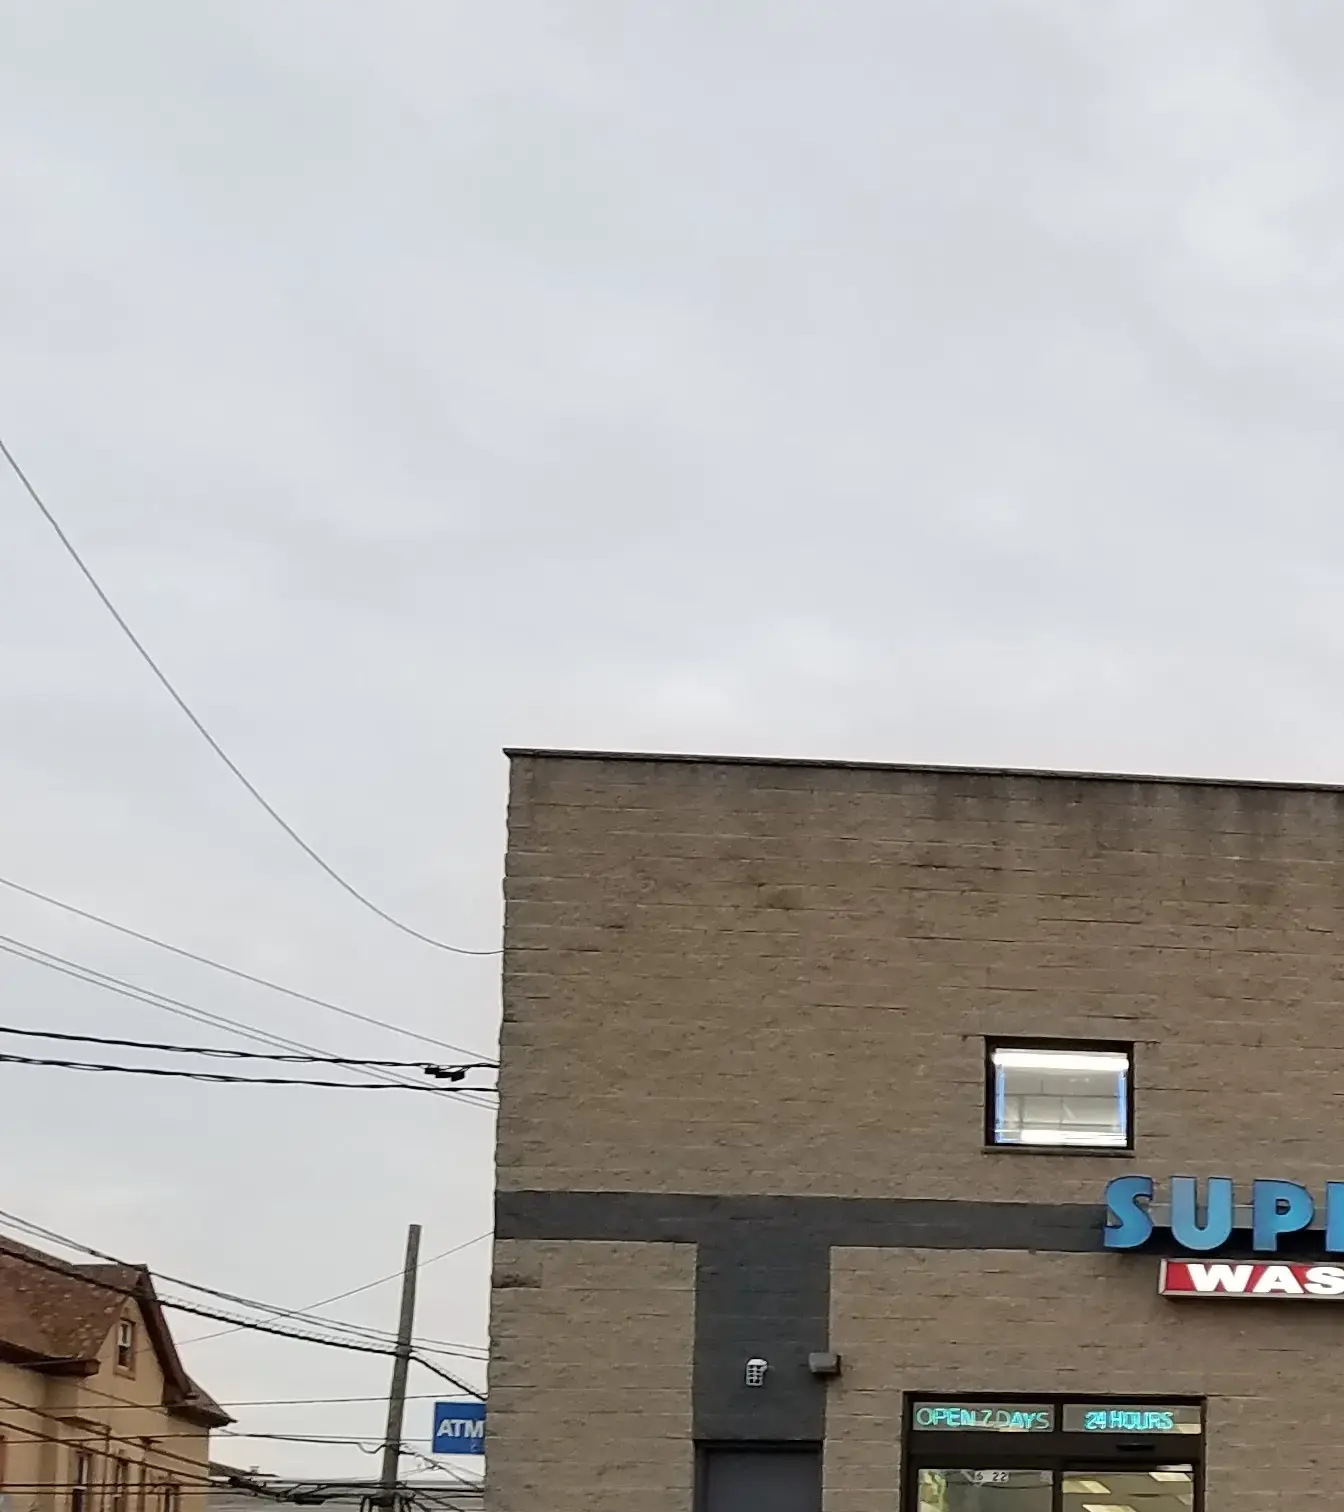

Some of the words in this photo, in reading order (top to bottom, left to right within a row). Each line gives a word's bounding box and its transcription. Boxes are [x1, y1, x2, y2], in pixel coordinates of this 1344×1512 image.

[436, 1418, 485, 1438] ATM
[915, 1407, 976, 1427] OPEN
[981, 1409, 993, 1423] 7
[996, 1409, 1050, 1430] DAYS
[1084, 1410, 1107, 1430] 24
[1110, 1410, 1175, 1431] HOURS
